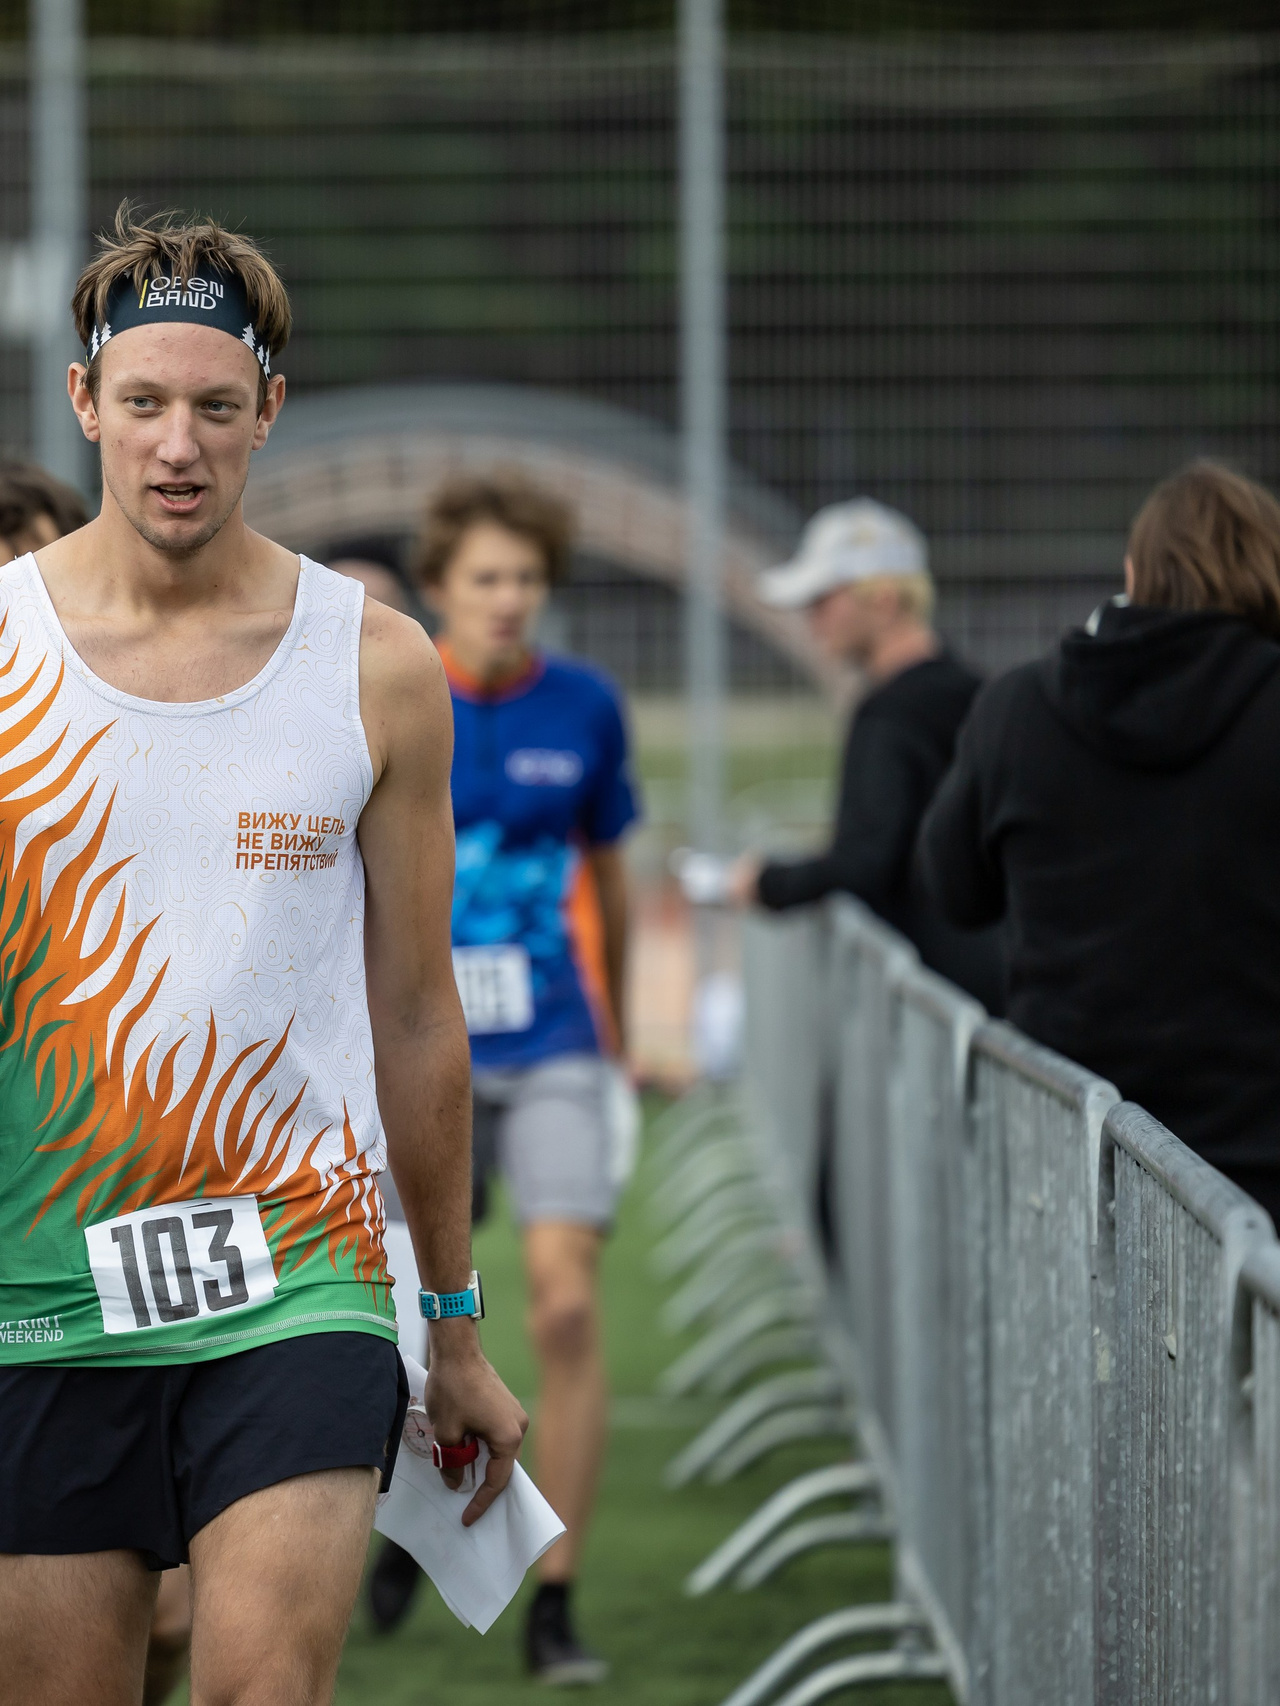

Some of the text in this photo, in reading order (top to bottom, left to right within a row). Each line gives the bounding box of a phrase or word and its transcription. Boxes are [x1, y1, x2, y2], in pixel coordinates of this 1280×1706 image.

[146, 290, 217, 310] BAND
[238, 812, 346, 836] ВИЖУ ЦЕЛЬ
[236, 832, 325, 852] НЕ ВИЖУ
[235, 848, 338, 871] ПРЕПЯТСТВИЙ
[110, 1208, 249, 1328] 103
